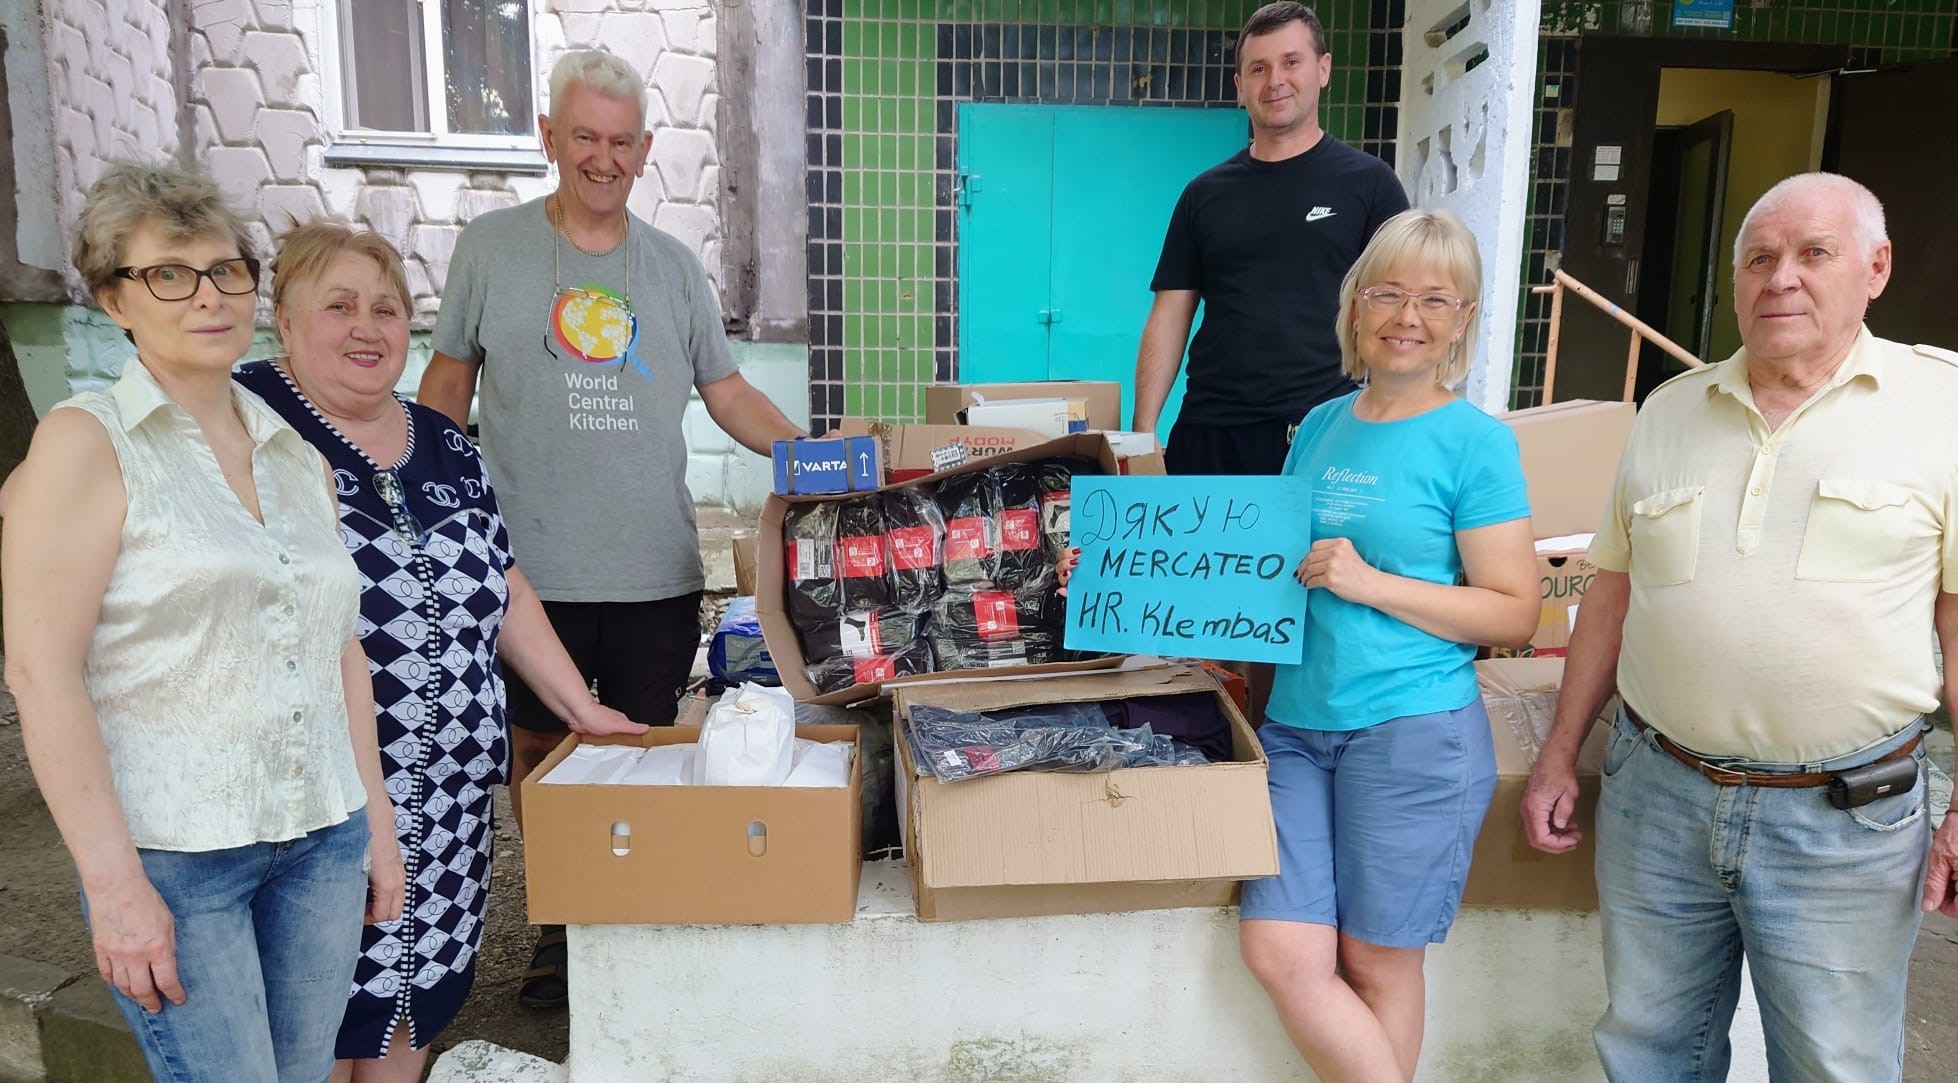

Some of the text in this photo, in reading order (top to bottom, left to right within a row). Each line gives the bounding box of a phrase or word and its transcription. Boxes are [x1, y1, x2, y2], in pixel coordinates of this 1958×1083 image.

[1310, 206, 1332, 215] NIKE
[564, 373, 618, 391] World
[568, 393, 634, 411] Central
[569, 413, 639, 431] Kitchen
[802, 460, 847, 472] VARTA
[1321, 466, 1379, 485] Reflection
[1080, 488, 1261, 546] ДЯКУЮ
[1099, 546, 1286, 581] MERCATEO
[1078, 591, 1129, 636] HR.
